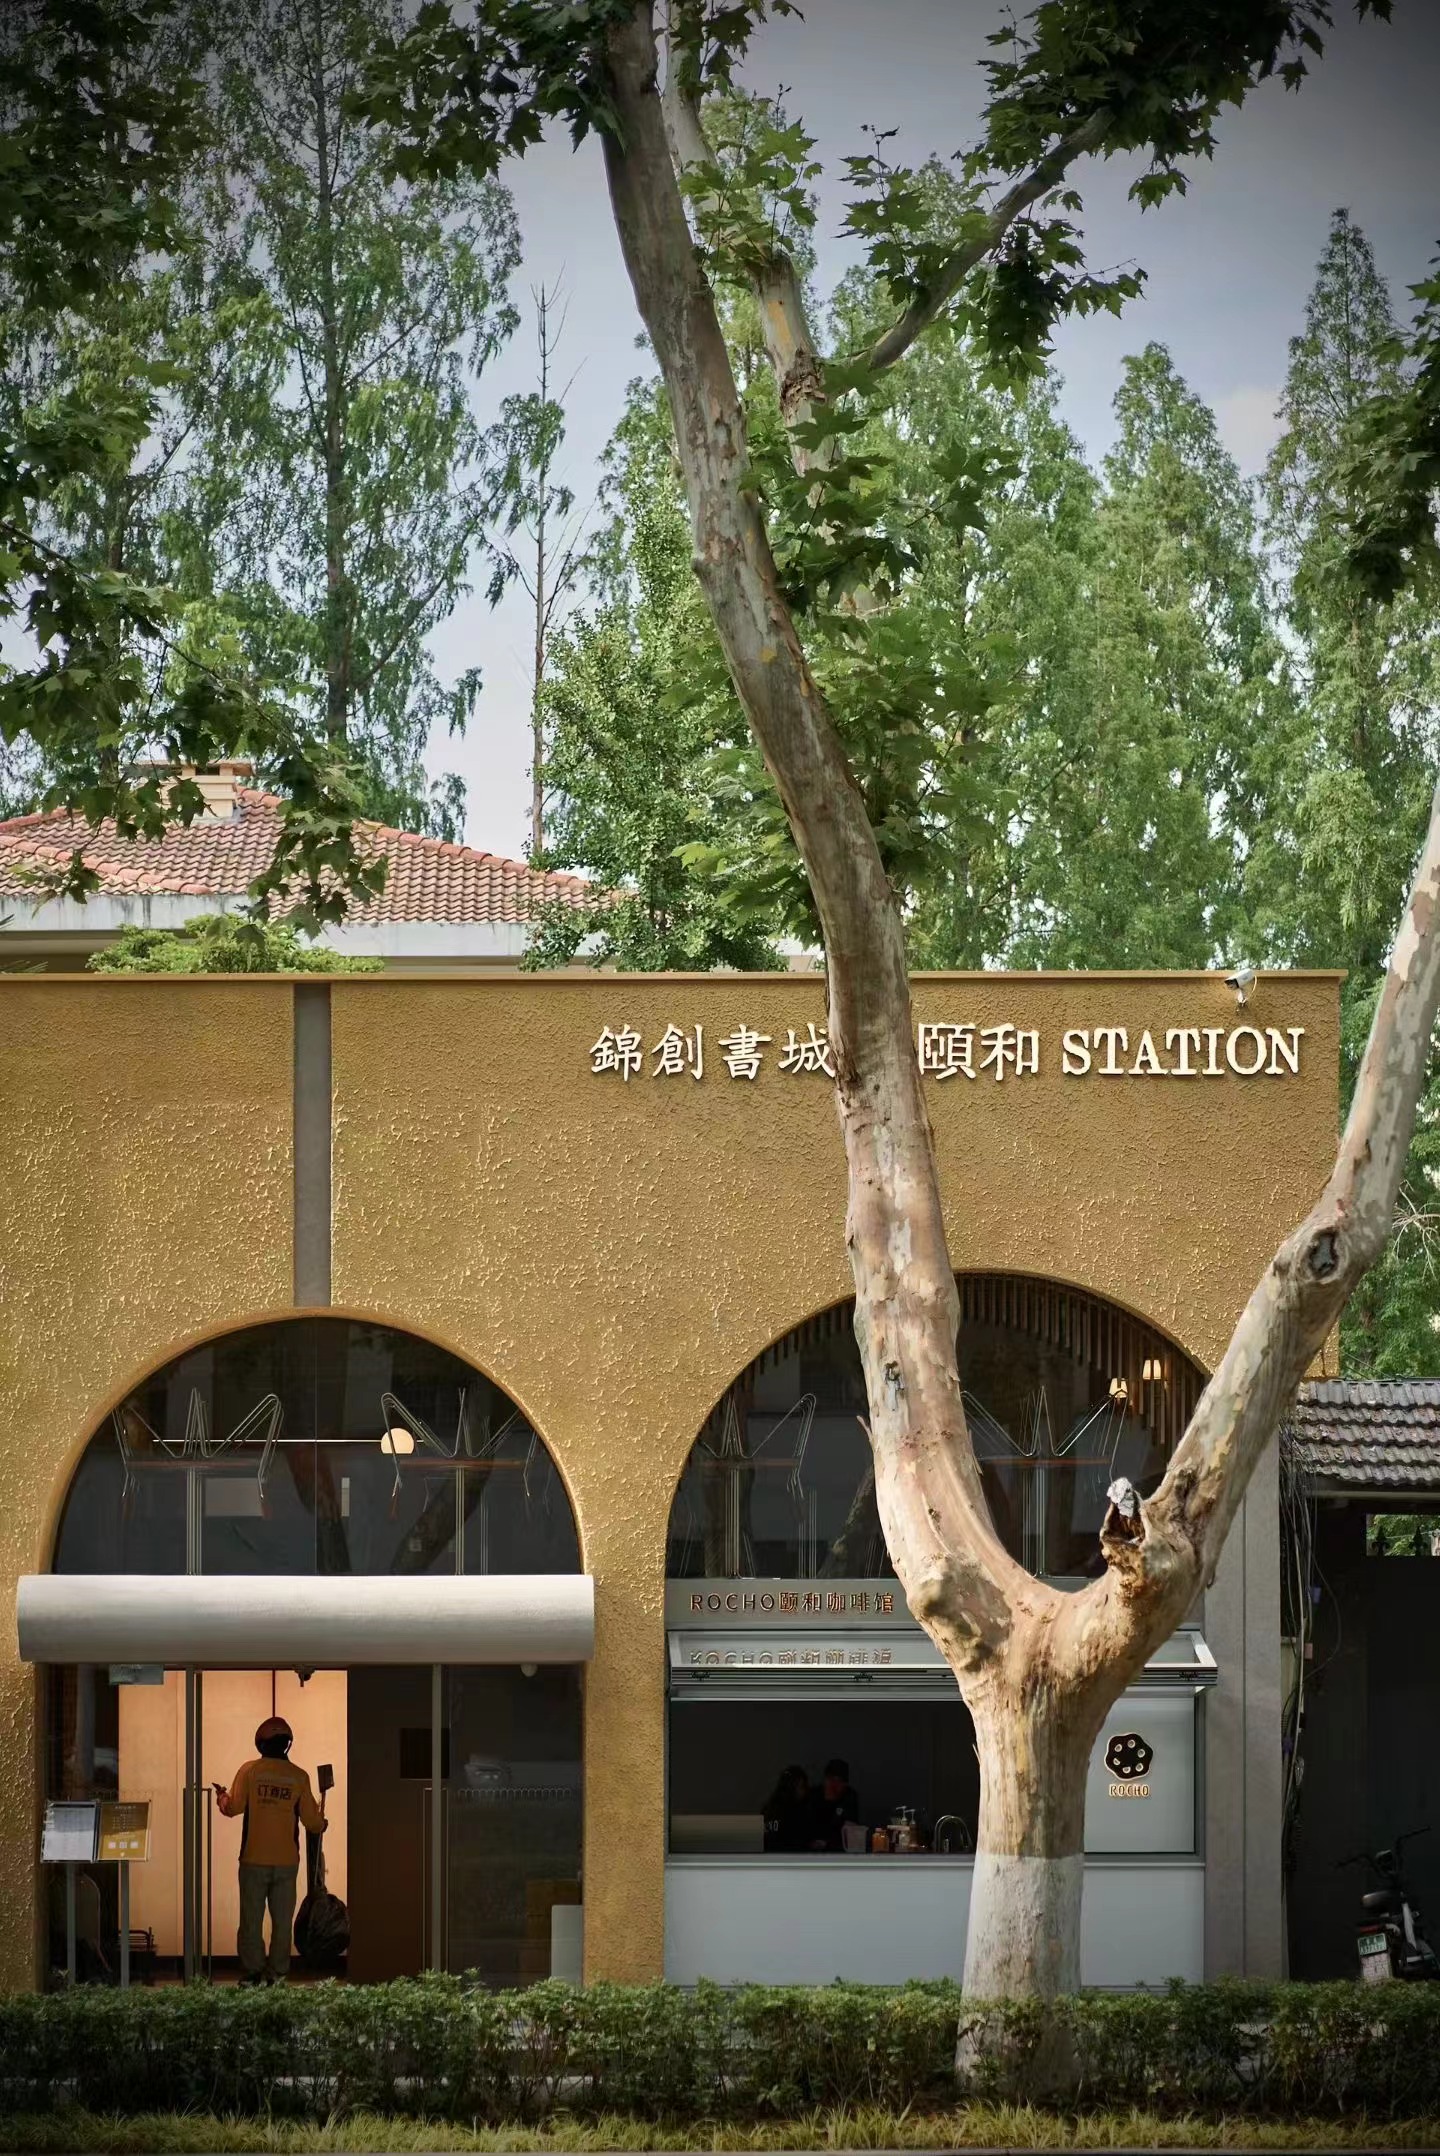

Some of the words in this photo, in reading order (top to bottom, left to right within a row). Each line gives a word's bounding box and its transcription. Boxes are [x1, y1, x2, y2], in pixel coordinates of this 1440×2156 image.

[589, 1022, 836, 1081] 錦創書城
[918, 1022, 1039, 1081] 頤和
[1062, 1026, 1305, 1076] STATION
[1109, 1784, 1150, 1797] ROCHO
